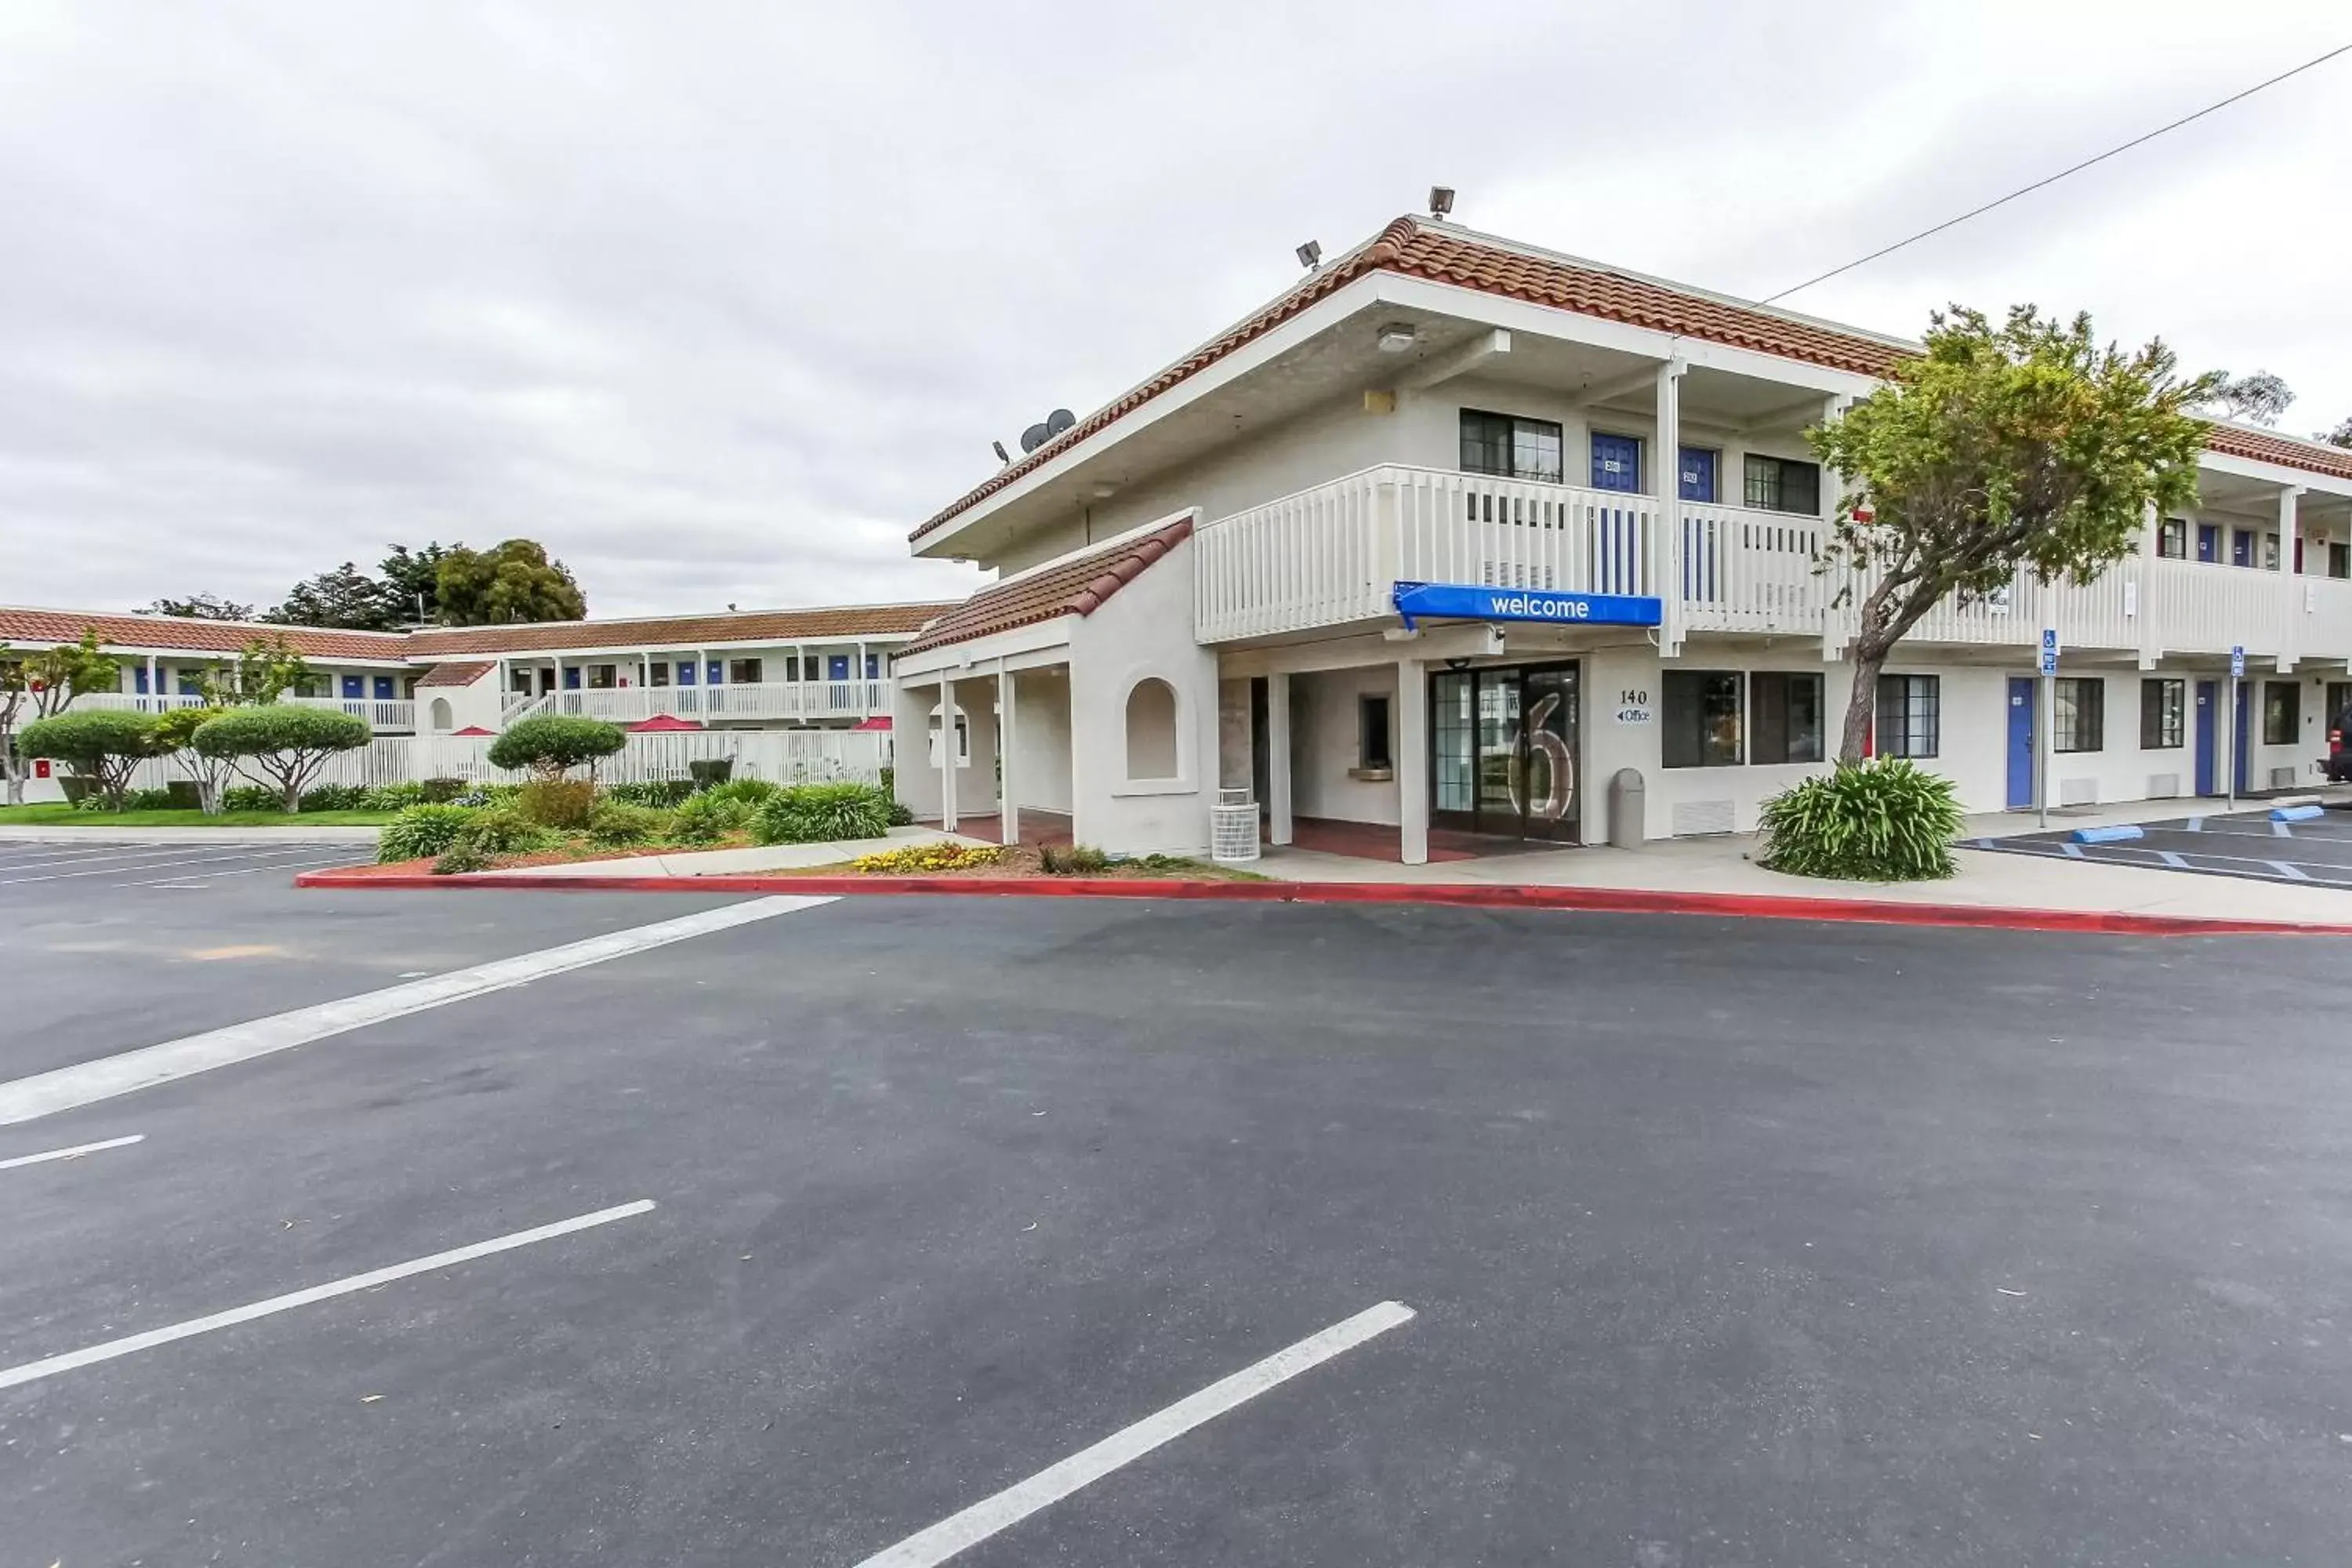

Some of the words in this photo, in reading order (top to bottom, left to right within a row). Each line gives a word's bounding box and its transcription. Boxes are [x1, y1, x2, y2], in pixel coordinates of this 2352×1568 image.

[1491, 593, 1589, 619] welcome
[1621, 689, 1647, 705] 140
[1625, 710, 1650, 722] Office
